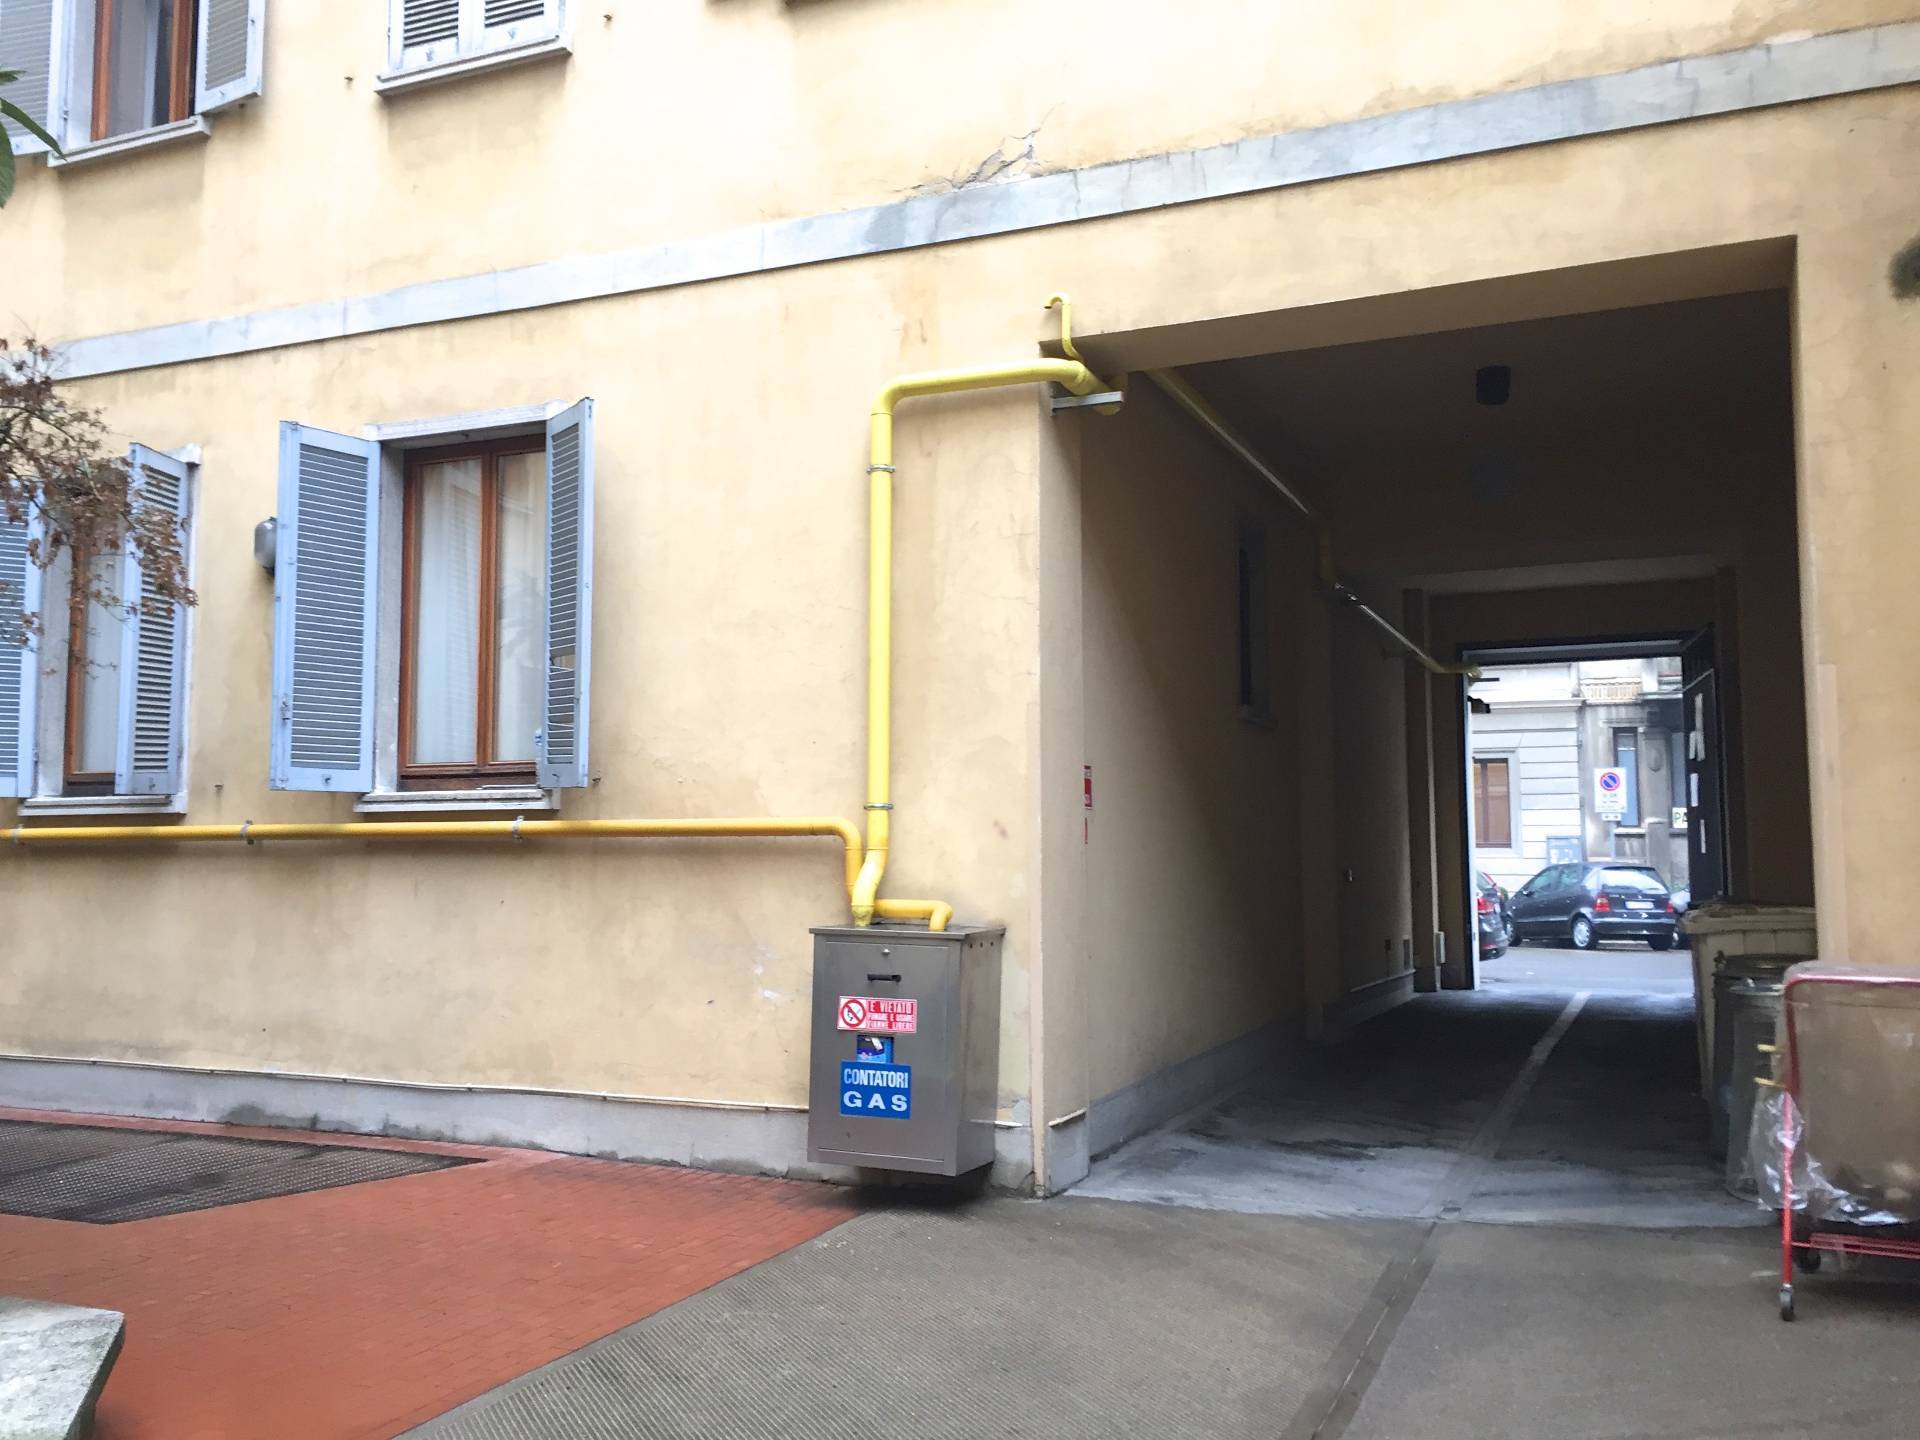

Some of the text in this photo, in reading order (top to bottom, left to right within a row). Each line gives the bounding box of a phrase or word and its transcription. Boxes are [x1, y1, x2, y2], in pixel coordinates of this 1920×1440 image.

[880, 1001, 912, 1014] VIETATO
[843, 1068, 909, 1089] CONTATORI
[843, 1090, 908, 1112] GAS
